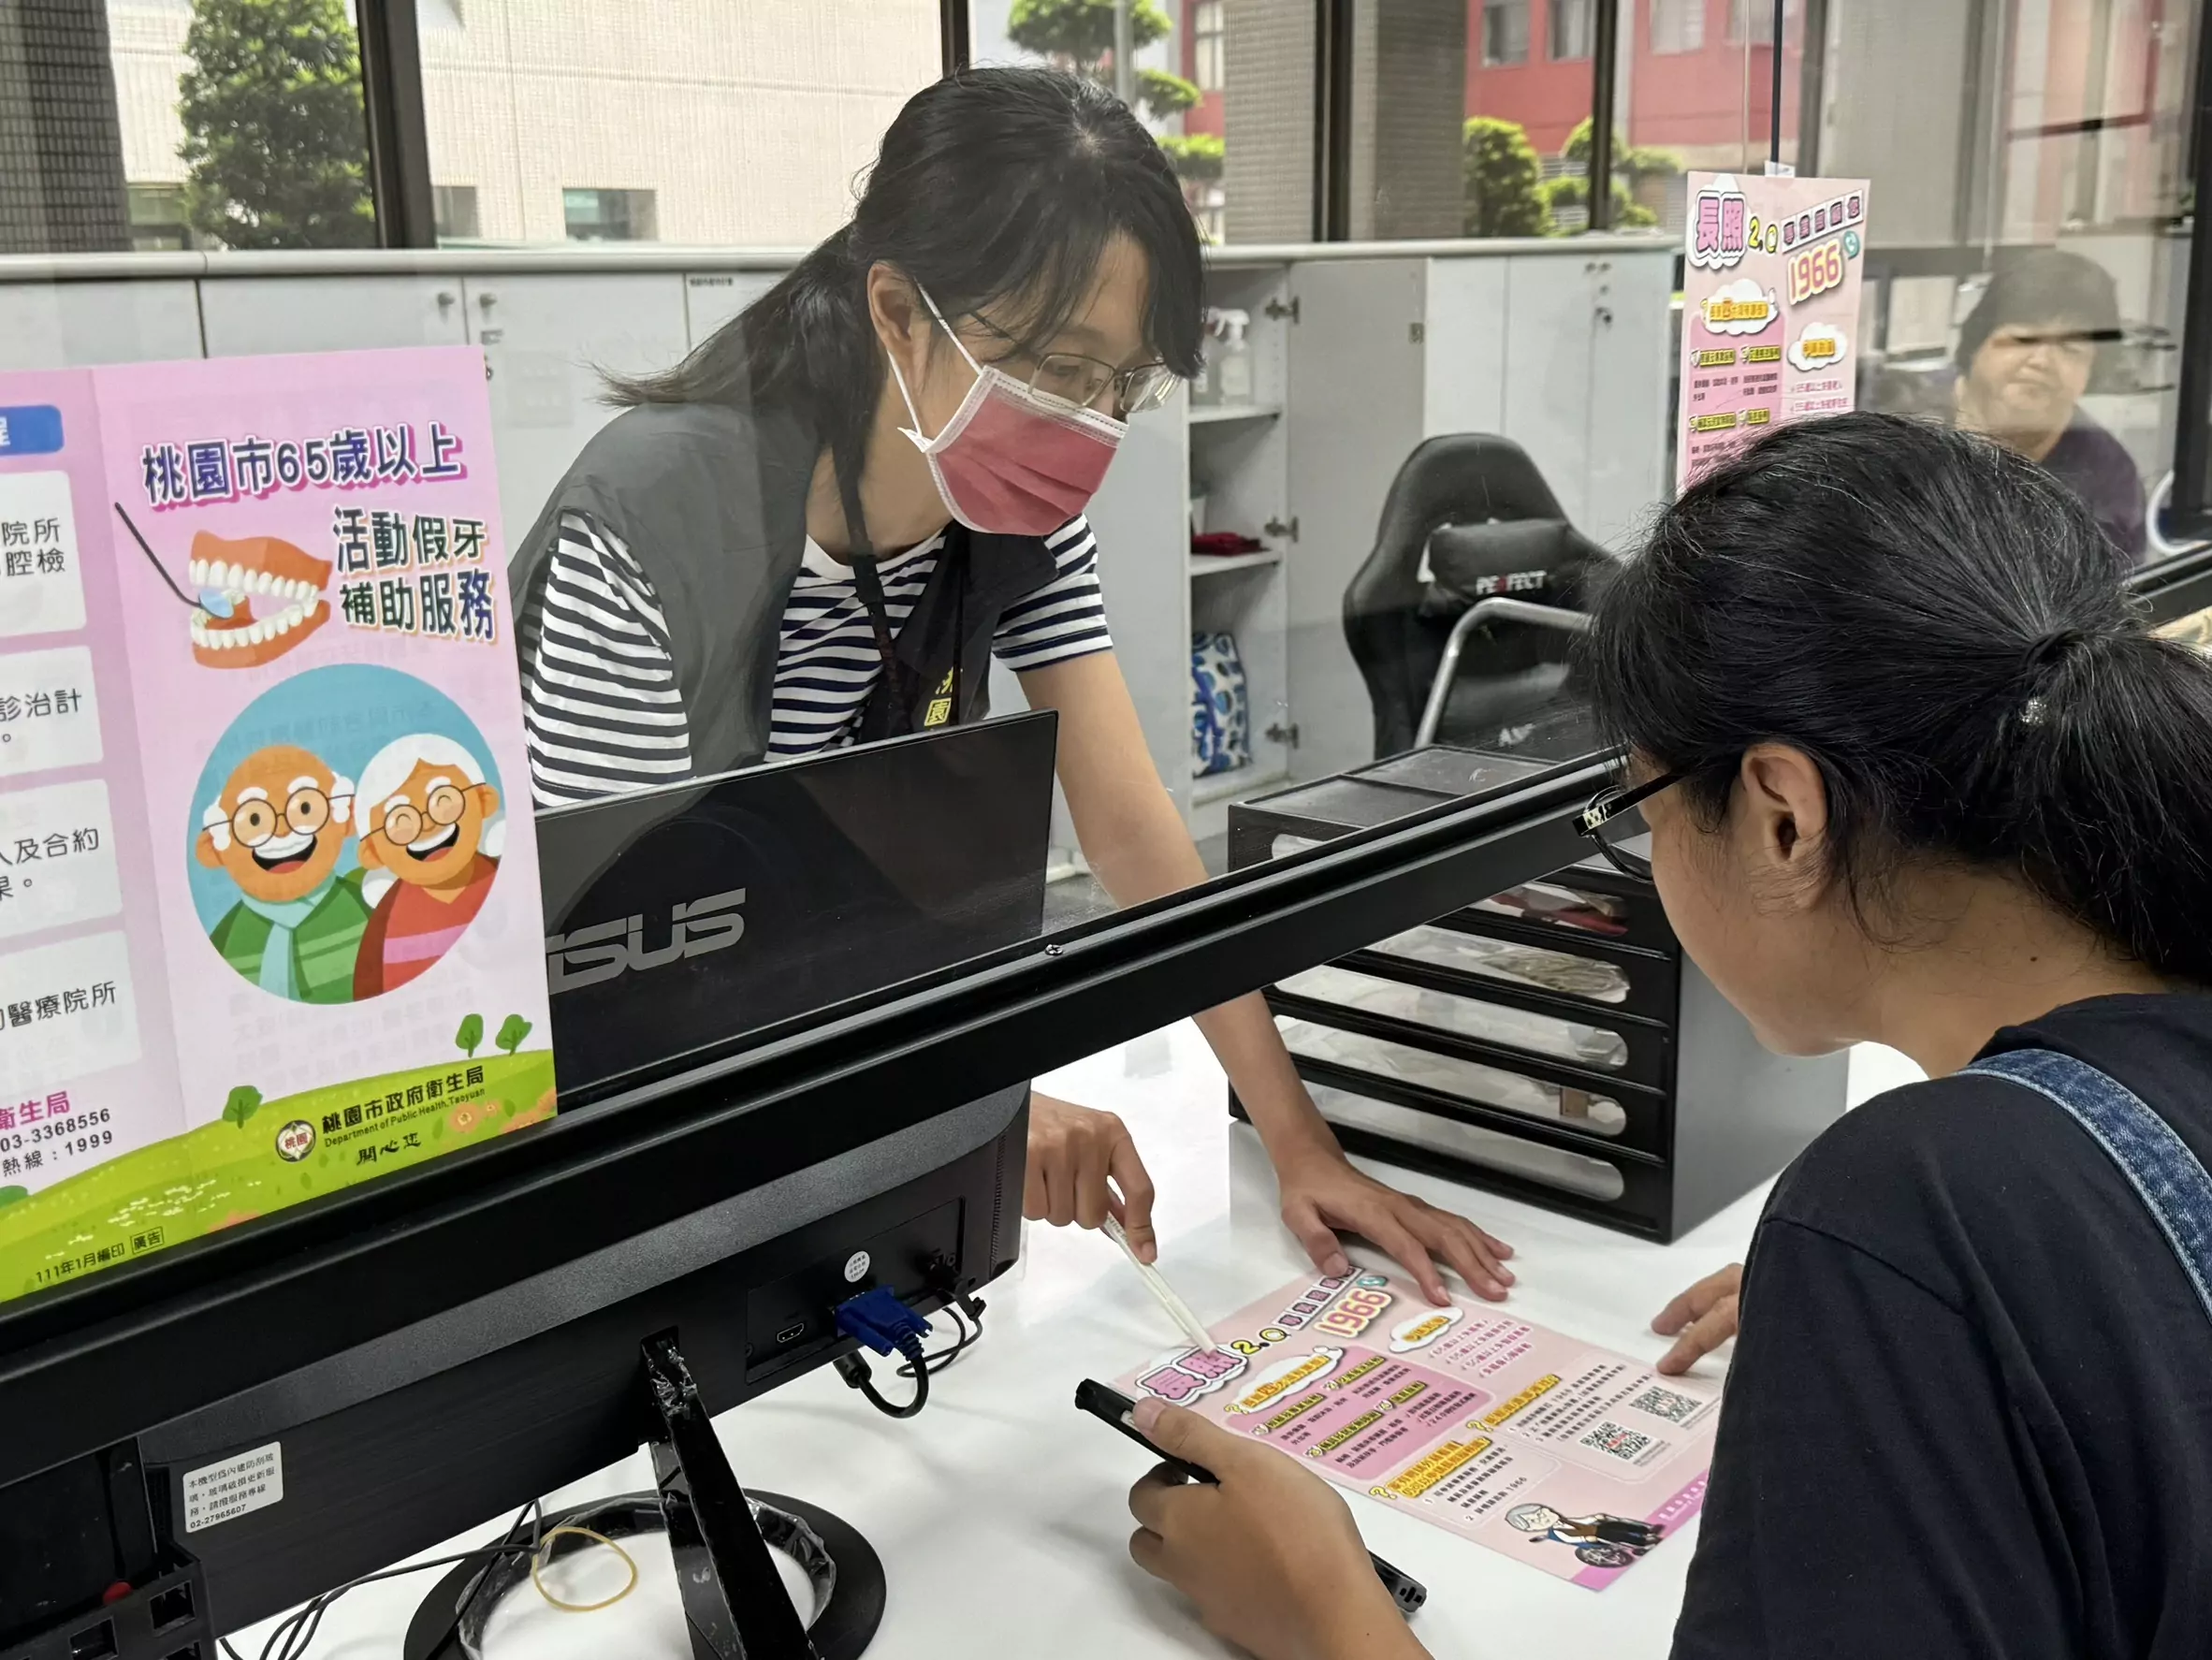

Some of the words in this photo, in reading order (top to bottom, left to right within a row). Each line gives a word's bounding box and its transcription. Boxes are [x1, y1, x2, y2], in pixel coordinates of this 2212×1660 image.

[1695, 193, 1745, 253] 長照
[1788, 241, 1842, 304] 1966
[142, 421, 464, 506] 桃園市65歲以上
[1, 517, 60, 546] 院所
[333, 506, 487, 574] 活動假牙
[341, 567, 497, 641] 補助服務
[0, 982, 116, 1030] 醫療院所
[321, 1065, 485, 1135] 桃園市政府衛生局
[0, 1108, 111, 1153] 03-3368556
[284, 1131, 310, 1150] 桃園
[324, 1123, 379, 1148] Department
[389, 1110, 418, 1128] Public
[132, 1229, 163, 1253] 廣告
[1316, 1290, 1390, 1337] 1966
[1137, 1347, 1247, 1401] 長照
